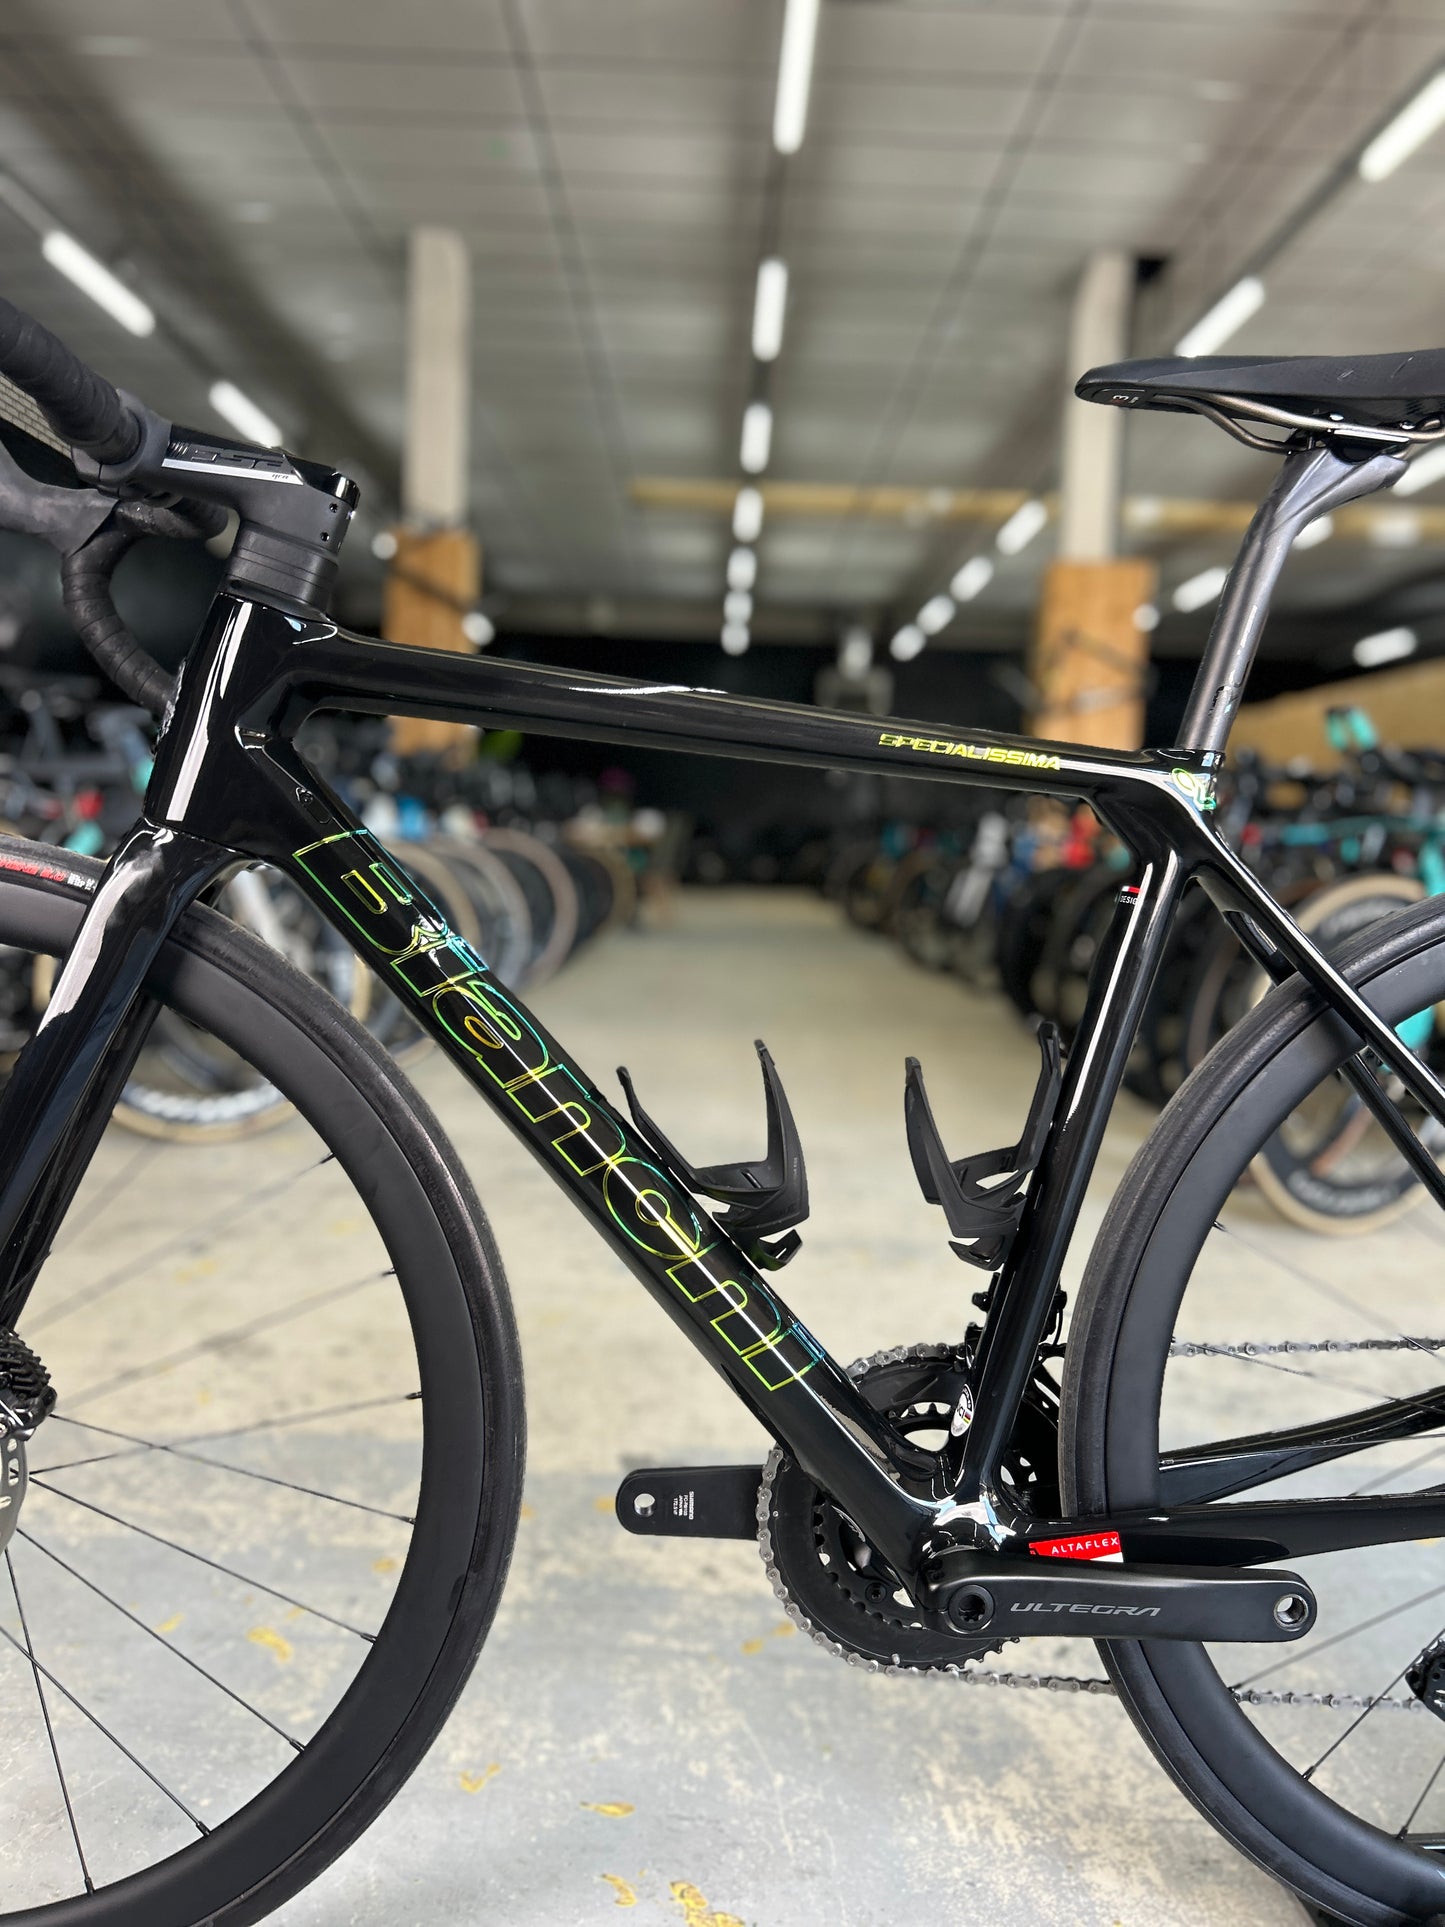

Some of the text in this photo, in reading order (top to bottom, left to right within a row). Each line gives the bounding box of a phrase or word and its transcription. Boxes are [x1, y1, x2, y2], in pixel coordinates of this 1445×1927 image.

[878, 733, 1061, 771] SPECIALISSIMA
[1120, 895, 1138, 906] DESIG
[293, 829, 824, 1391] Bianchi
[1051, 1537, 1119, 1555] ALTAFLEX
[1010, 1602, 1161, 1617] ULTEGRA
